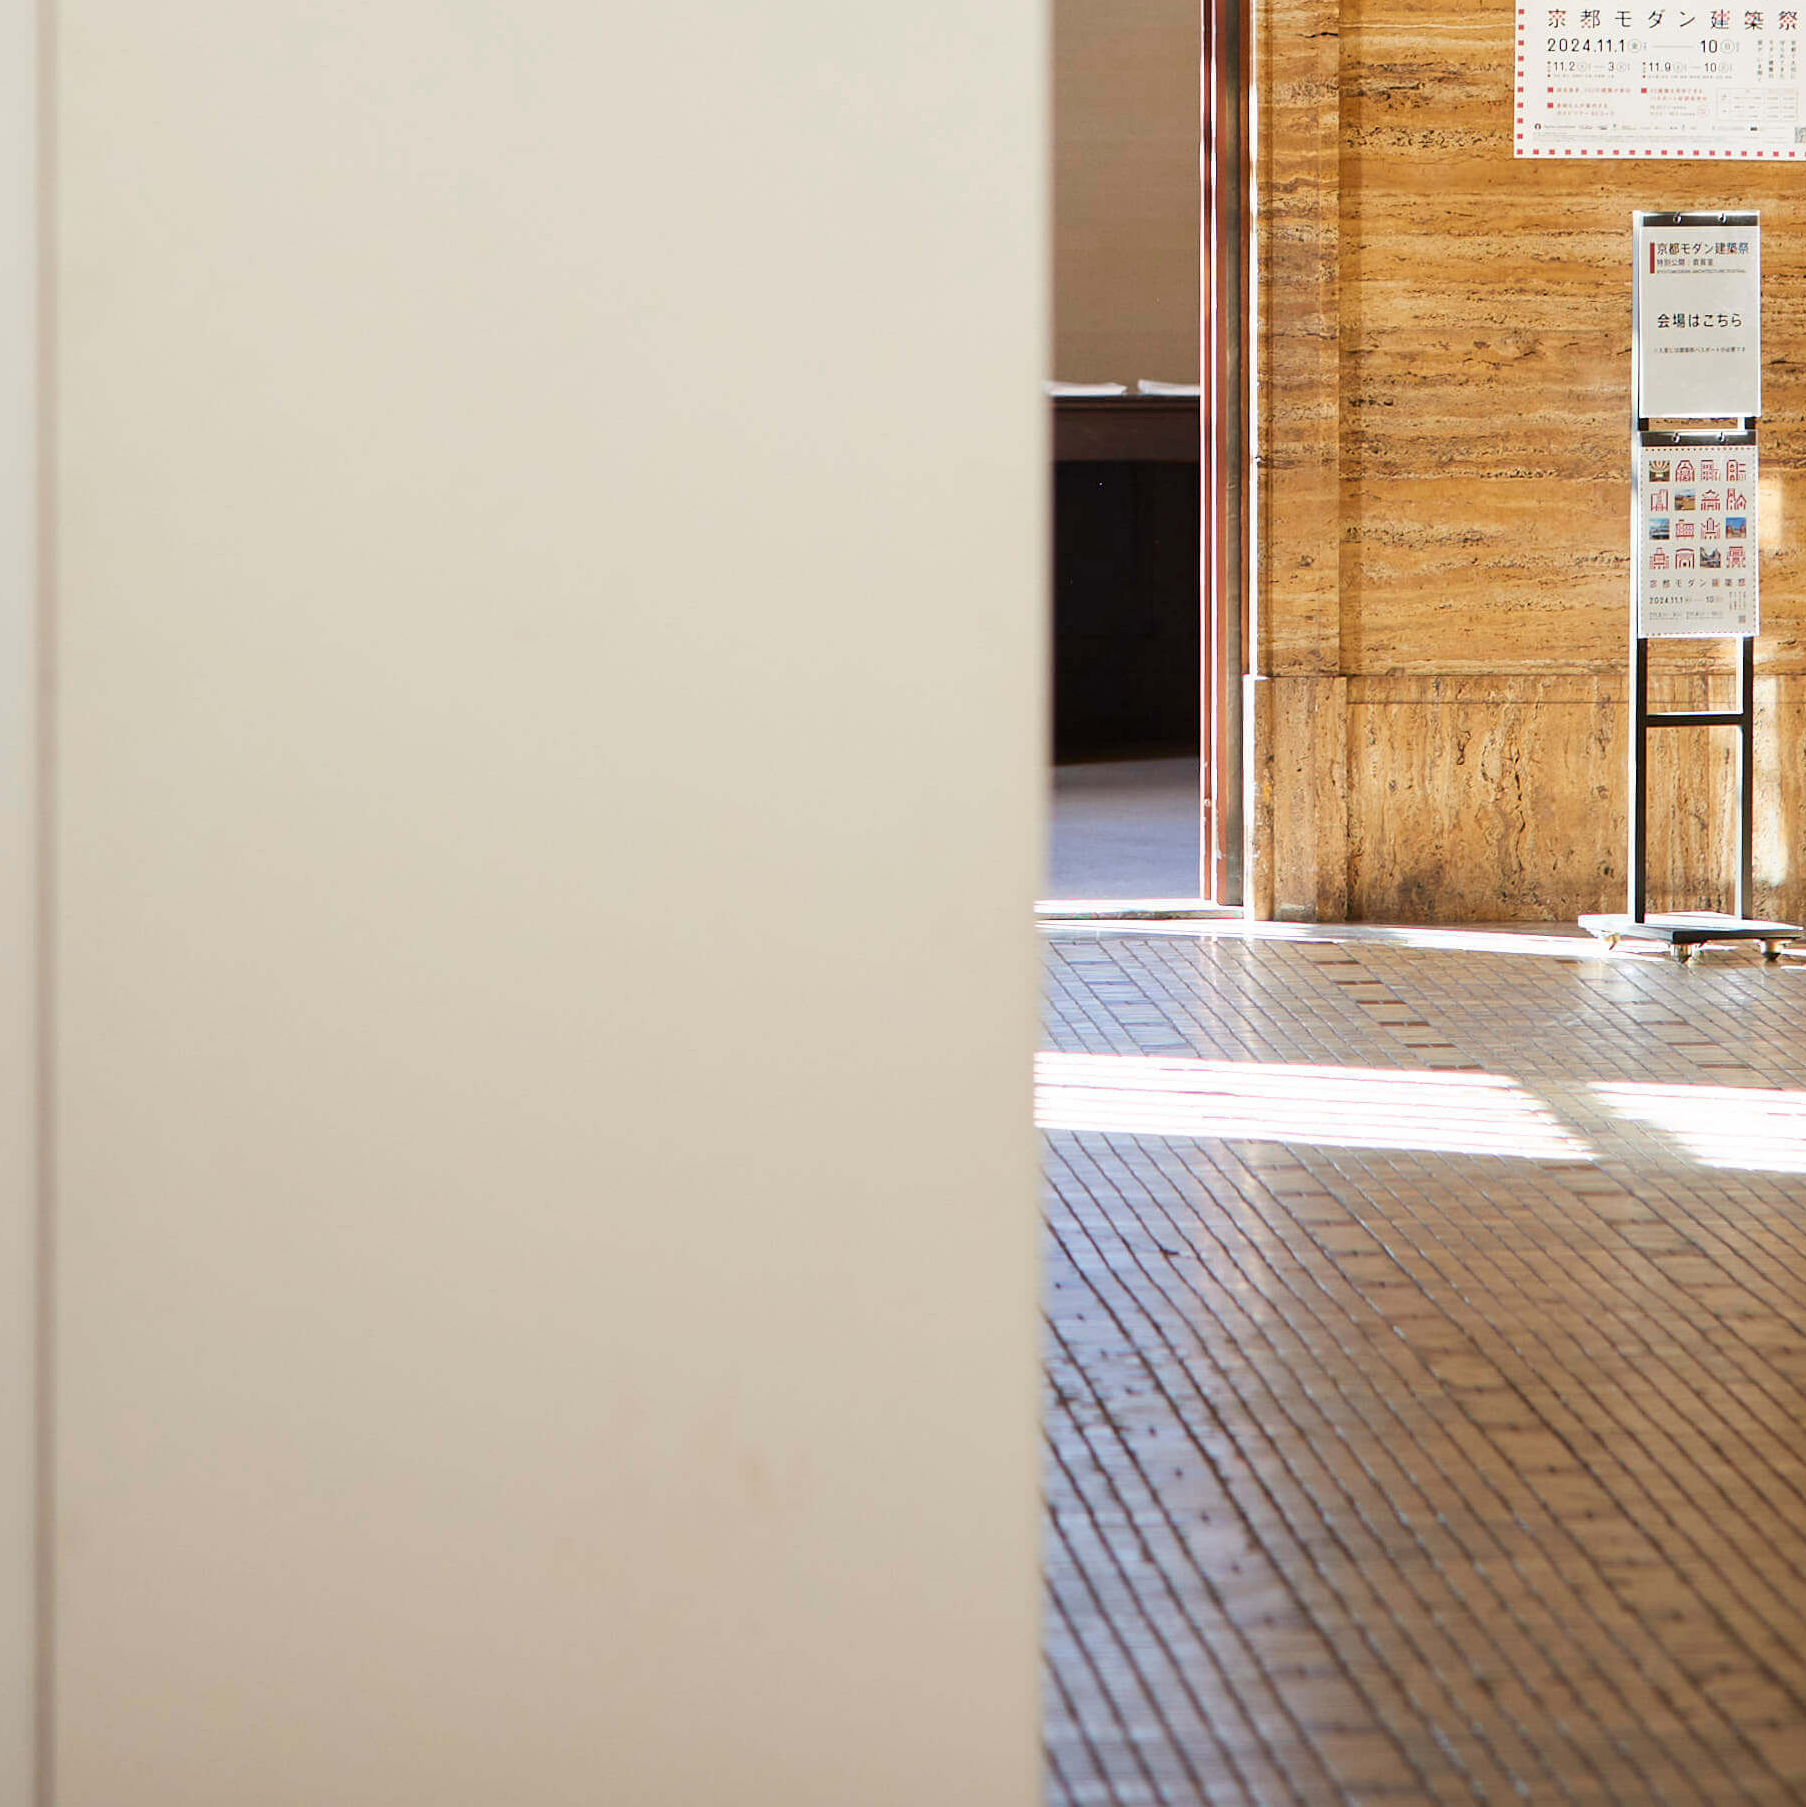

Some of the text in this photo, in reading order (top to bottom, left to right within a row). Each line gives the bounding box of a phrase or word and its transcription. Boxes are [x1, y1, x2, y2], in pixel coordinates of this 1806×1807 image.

[1547, 8, 1799, 31] 京都モダン建築祭
[1547, 38, 1625, 53] 2024.11.1
[1658, 313, 1742, 328] 会場はこちら
